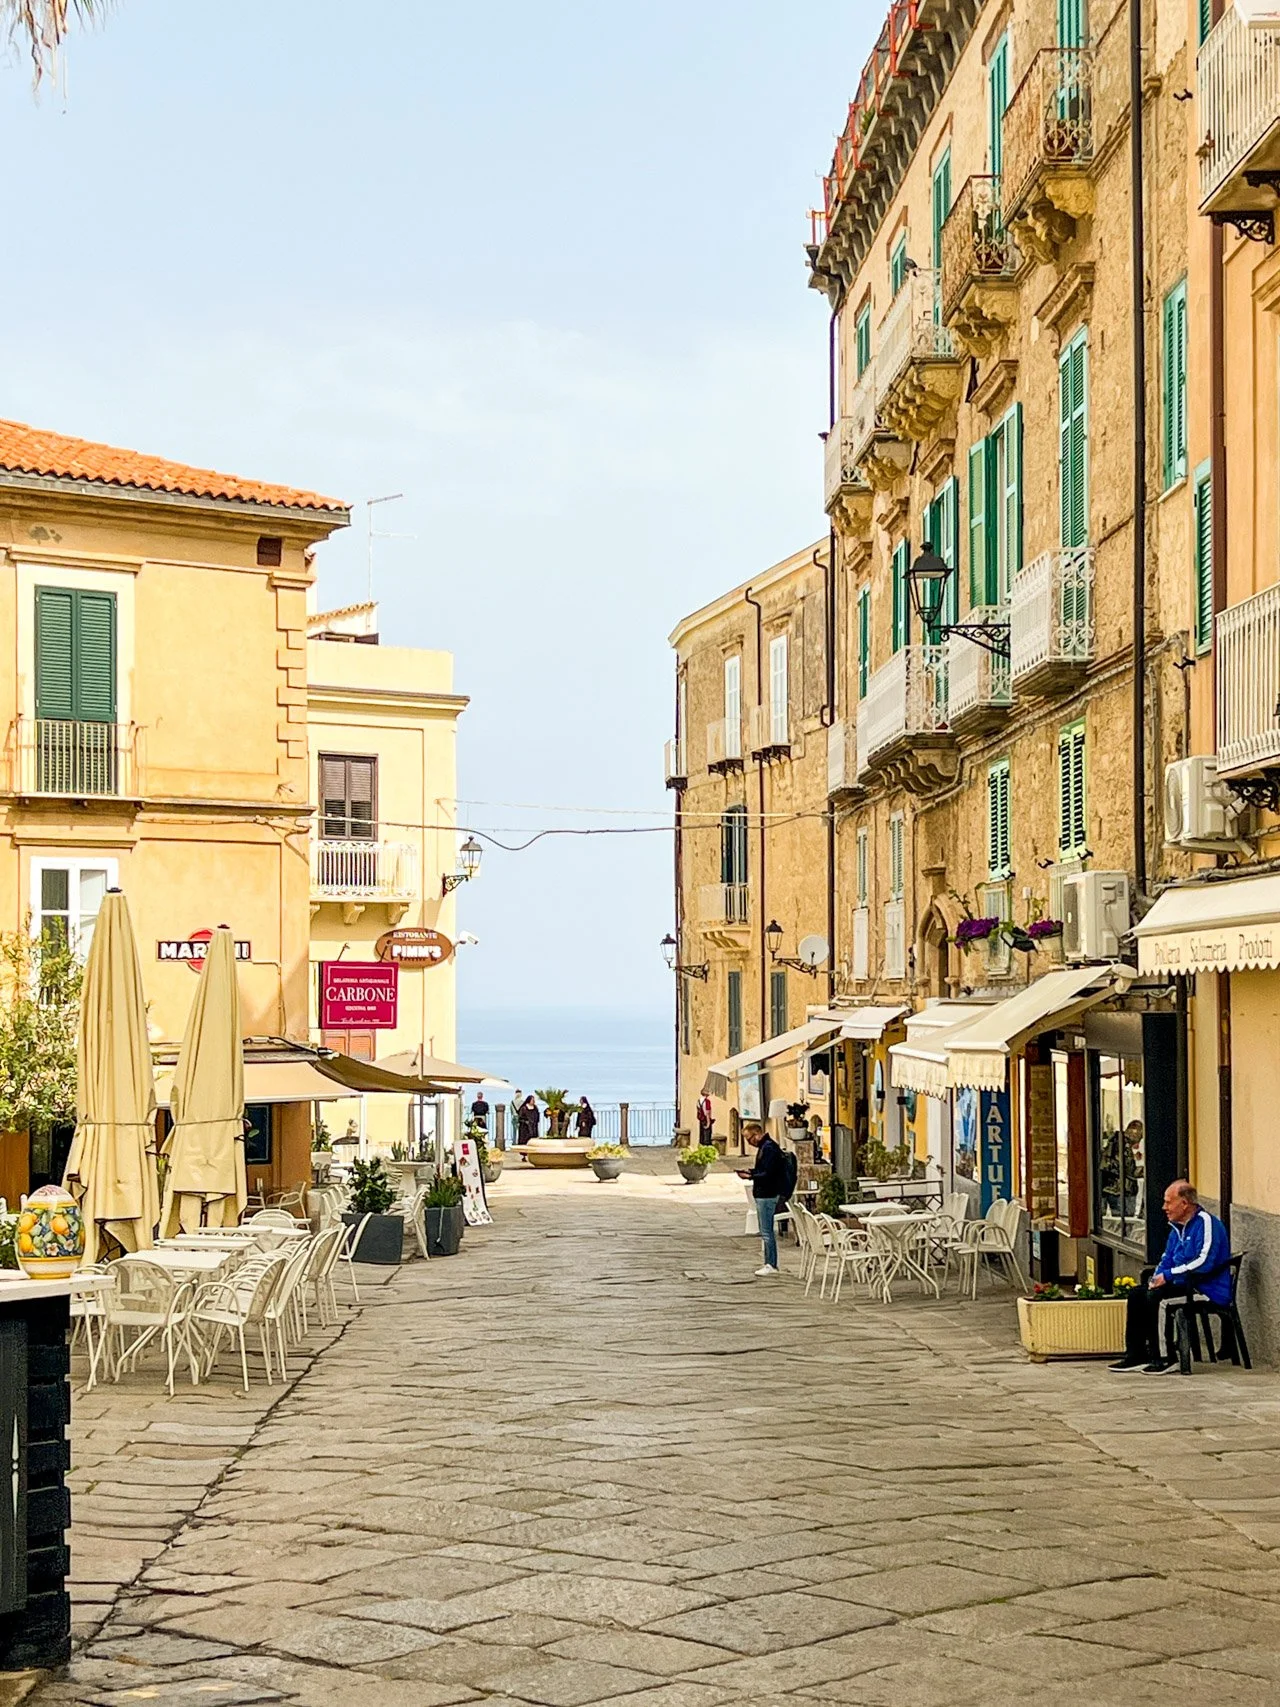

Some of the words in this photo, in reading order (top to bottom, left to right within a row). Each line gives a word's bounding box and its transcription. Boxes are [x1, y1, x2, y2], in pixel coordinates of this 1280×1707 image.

[160, 942, 250, 959] MARI
[391, 944, 443, 959] PIMM'S
[1189, 936, 1227, 963] Salumeria
[1238, 931, 1273, 960] Prodotti
[325, 986, 396, 1002] CARBONE
